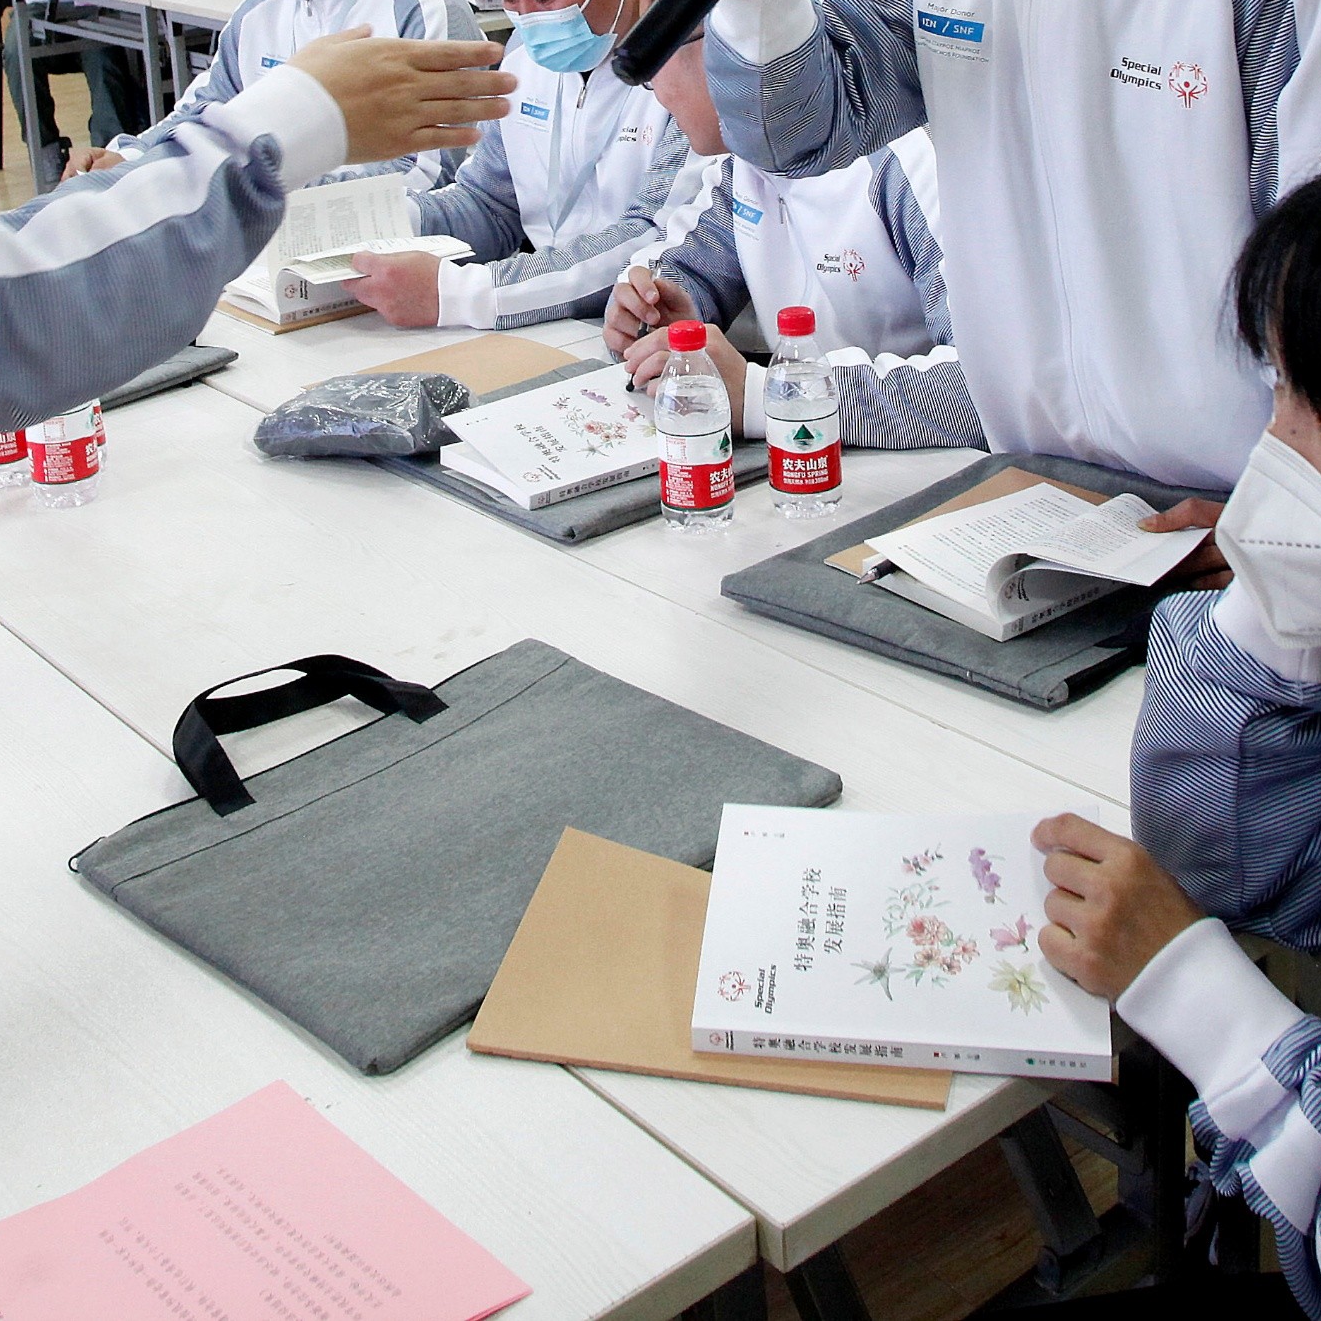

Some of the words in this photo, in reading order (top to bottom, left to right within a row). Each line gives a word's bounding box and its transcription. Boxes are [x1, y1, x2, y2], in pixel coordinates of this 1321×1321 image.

[927, 2, 948, 14] Major
[950, 8, 975, 17] Donor
[953, 24, 975, 35] SNF
[1121, 56, 1162, 76] Special
[1110, 68, 1162, 90] Olympics
[782, 457, 828, 471] 农夫山泉
[794, 868, 822, 972] 特奥融合学校
[824, 886, 848, 954] 发展指南
[754, 968, 766, 1009] Special
[764, 964, 777, 1014] Olympics
[753, 1036, 904, 1058] 特奥融合学校发展指南
